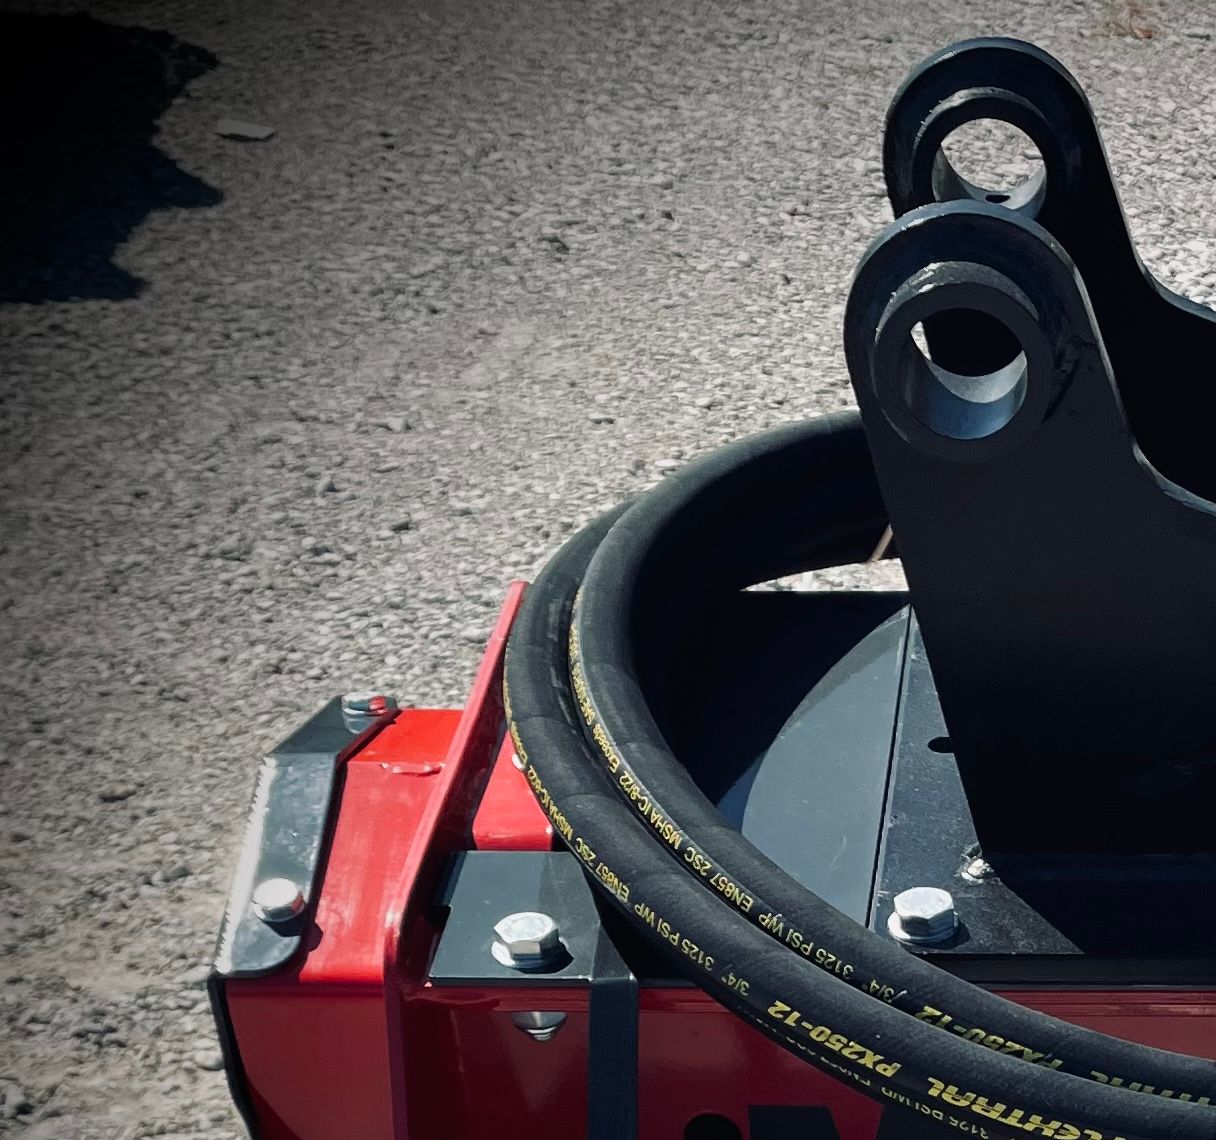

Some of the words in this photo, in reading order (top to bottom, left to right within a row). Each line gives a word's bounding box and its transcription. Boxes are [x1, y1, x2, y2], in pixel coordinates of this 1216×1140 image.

[619, 772, 652, 822] IC-8/22
[650, 814, 683, 850] MSHA
[575, 837, 597, 867] 2SC
[684, 846, 713, 876] 2SC
[596, 861, 631, 903] EN857
[709, 872, 754, 913] EN857
[634, 902, 656, 928] WP
[758, 912, 786, 938] WP
[657, 917, 681, 947] PSI
[785, 928, 814, 957] PSI
[681, 938, 716, 972] 3125
[816, 948, 854, 980] 3125
[720, 971, 751, 998] 3/4"
[767, 999, 903, 1078] PX250-12
